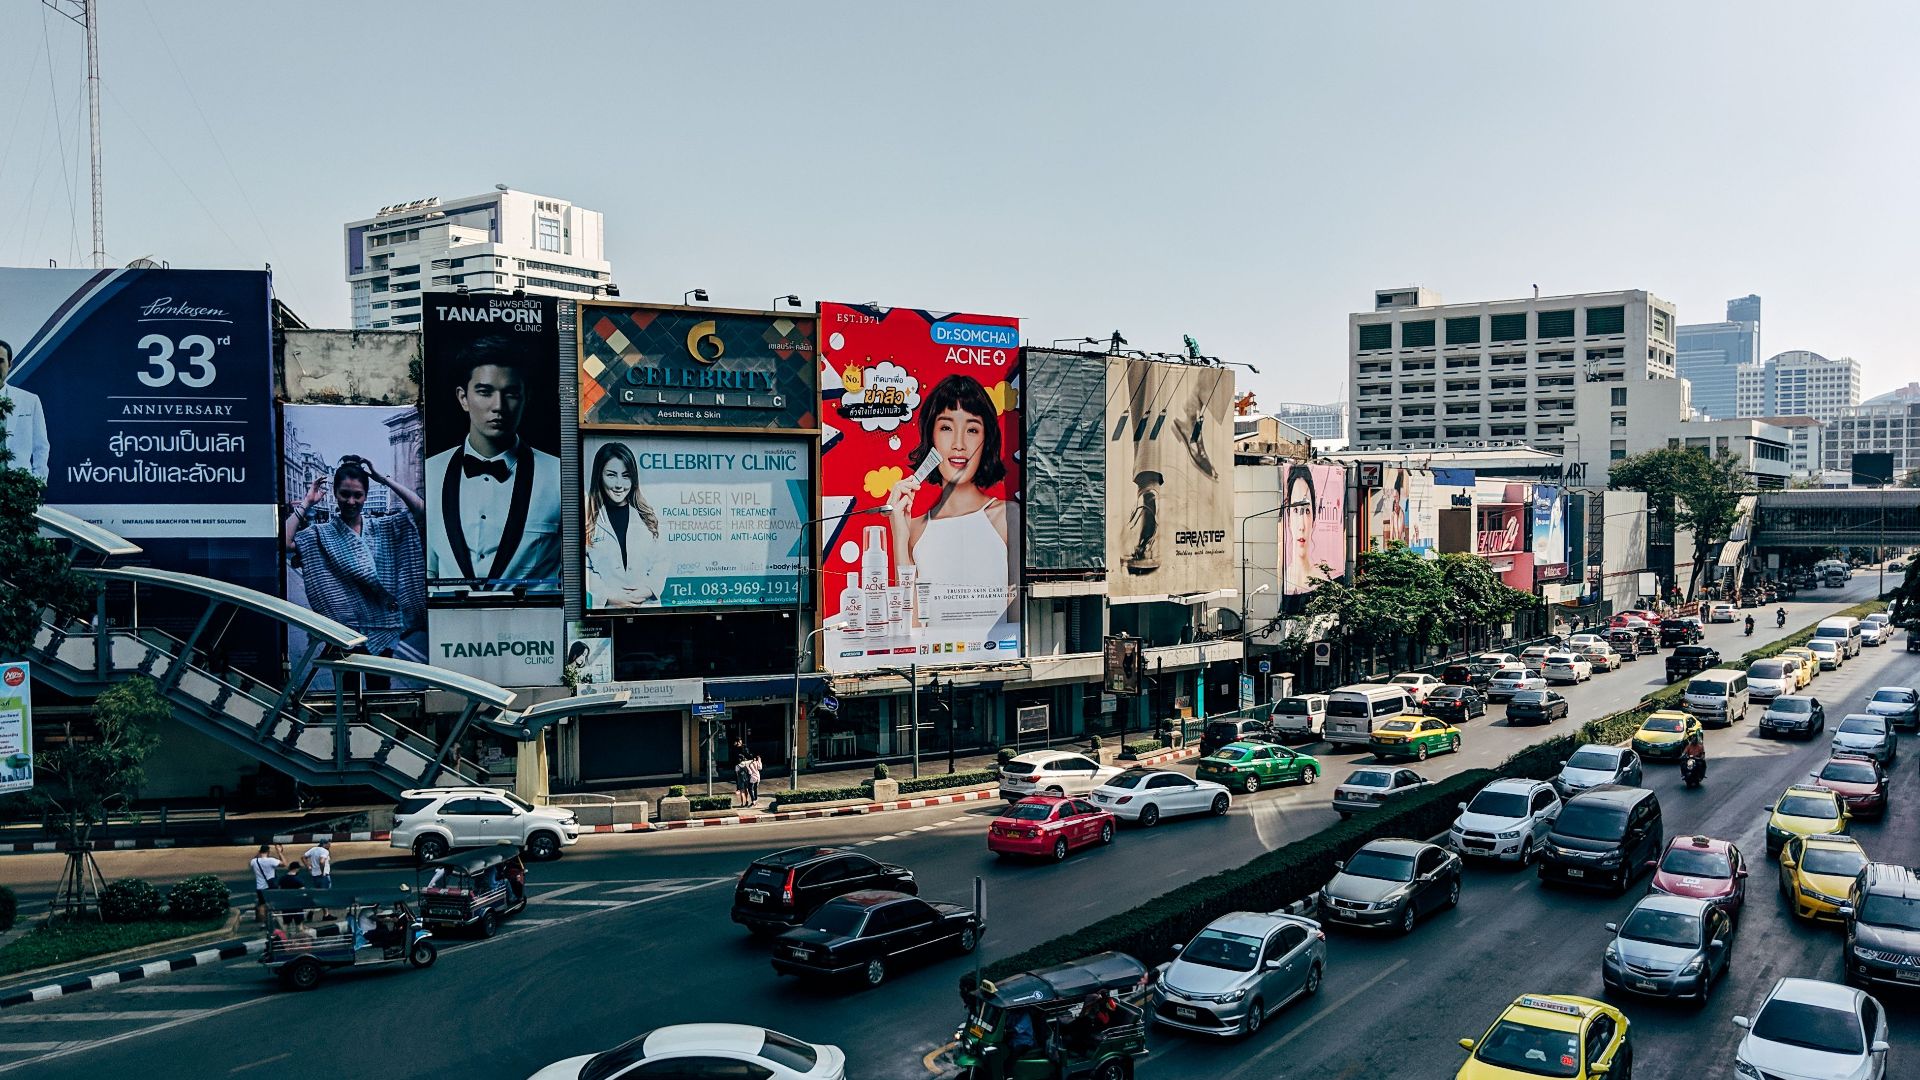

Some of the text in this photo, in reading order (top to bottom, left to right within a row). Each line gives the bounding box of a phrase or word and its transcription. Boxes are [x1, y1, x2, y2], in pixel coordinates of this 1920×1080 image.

[436, 306, 542, 324] TANAPORN
[836, 313, 880, 325] EST.1971
[514, 323, 542, 333] CLINIC
[944, 347, 991, 366] ACNE
[625, 366, 776, 390] CELEBRITY
[624, 390, 782, 407] CLINIC
[122, 404, 233, 416] ANNIVERSARY
[657, 410, 694, 419] Aesthetic
[703, 411, 721, 419] Skin
[109, 430, 246, 458] สู่ความเป็นเลิศ
[639, 452, 797, 471] CELEBRITY CLINIC
[67, 457, 247, 484] เพื่อคนไข้และสังคม
[680, 490, 722, 505] LASER
[731, 491, 761, 506] VIPL
[662, 507, 722, 517] FACIAL DESIGN
[731, 507, 777, 517] TREATMENT
[668, 520, 722, 531] THERMAGE
[731, 519, 802, 531] HAIR REMOVAL
[668, 532, 722, 542] LIPOSUCTION
[730, 532, 778, 542] ANTI-AGING
[670, 581, 799, 597] Tel. 083-969-1914
[865, 583, 886, 591] ACNE
[845, 604, 862, 612] ACNE
[440, 640, 555, 658] TANAPORN
[525, 656, 555, 665] CLINIC
[643, 684, 676, 697] beauty
